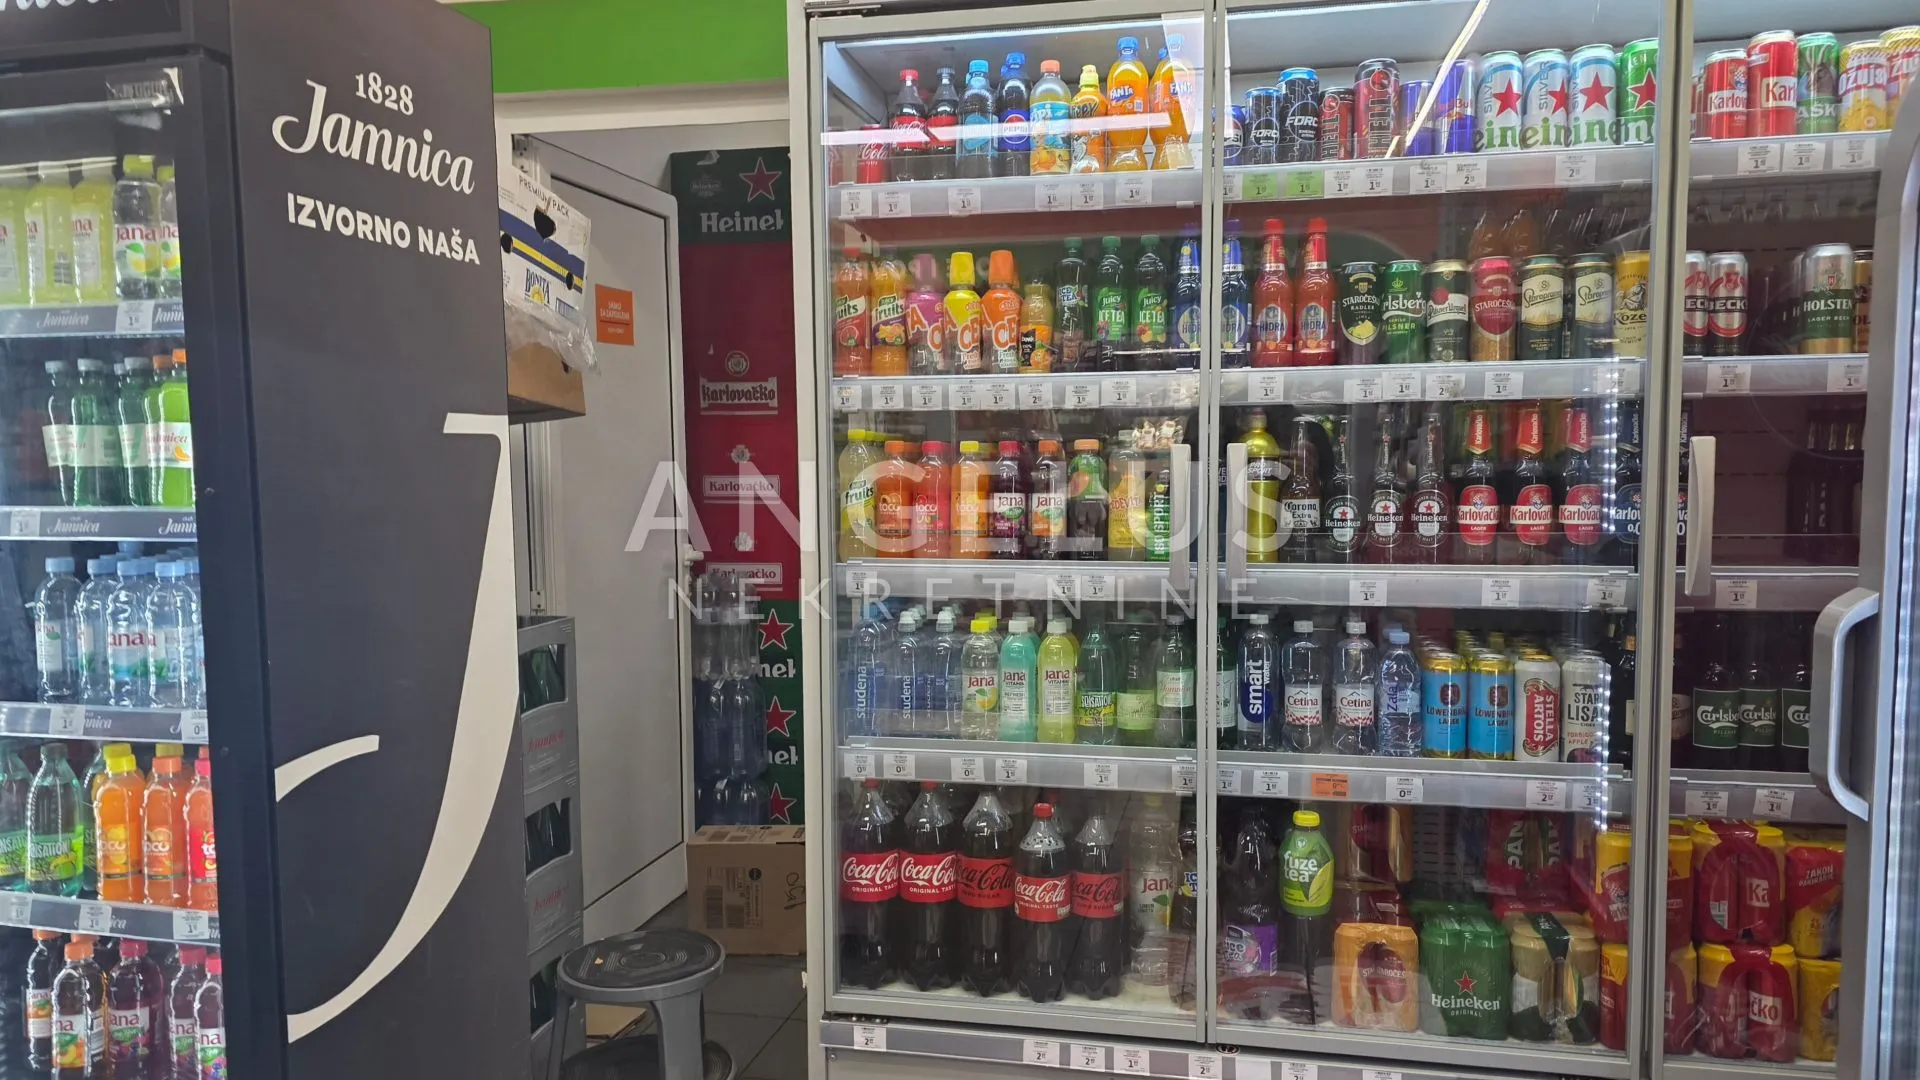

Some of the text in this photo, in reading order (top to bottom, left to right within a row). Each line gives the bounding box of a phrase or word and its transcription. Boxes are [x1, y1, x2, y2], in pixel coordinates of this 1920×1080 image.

[355, 72, 414, 116] 1828
[1109, 85, 1135, 100] FANTA
[271, 79, 475, 195] Jamnica
[287, 192, 480, 265] IZVORNO NAŠA
[1325, 519, 1361, 528] Heineken
[1367, 513, 1404, 522] Heineken
[1411, 513, 1448, 522] Heineken
[1264, 660, 1272, 685] water
[854, 665, 867, 720] studena
[1249, 659, 1263, 715] smart
[1287, 695, 1319, 707] Cetina
[1340, 696, 1372, 708] Cetina
[1533, 693, 1544, 742] ARTOIS
[1545, 694, 1555, 742] STELLA
[1283, 851, 1318, 872] fuze
[1284, 868, 1312, 883] tea
[1805, 864, 1835, 880] ZAKON
[909, 886, 940, 894] ORIGINAL
[1015, 876, 1066, 903] Coca-Cola
[1431, 993, 1502, 1011] Heineken
